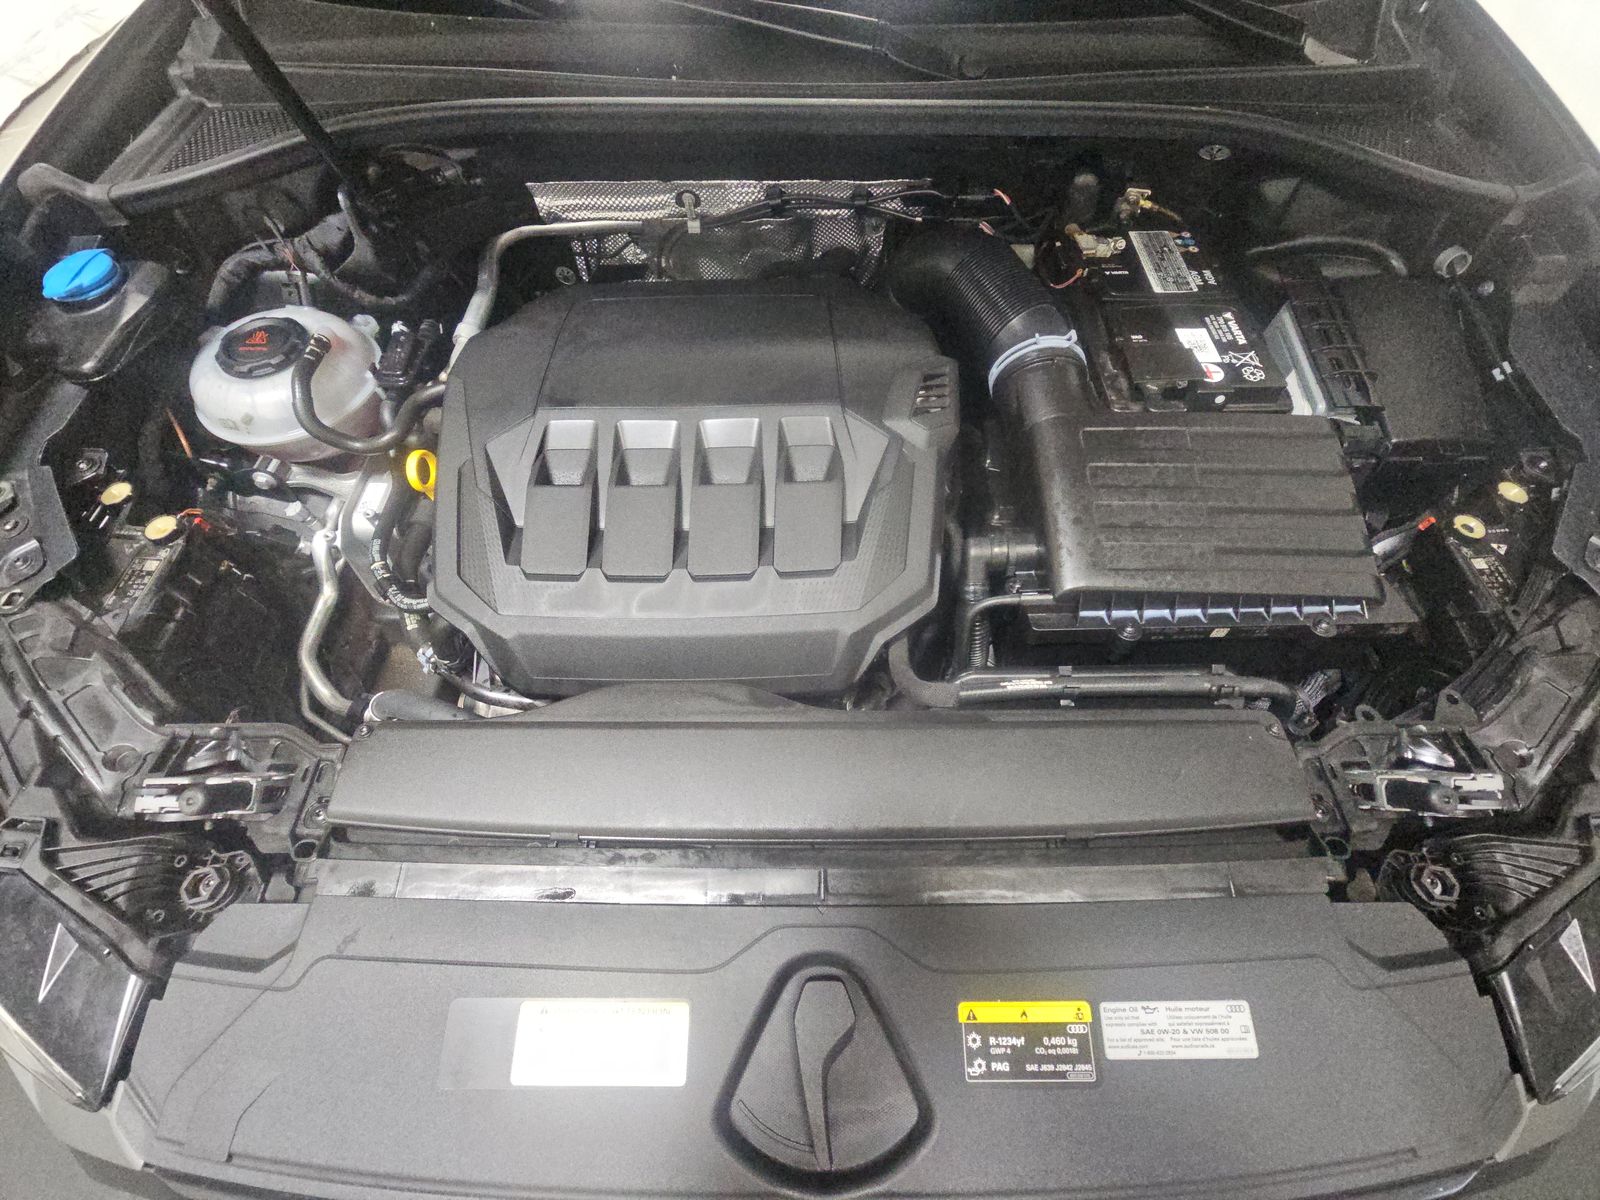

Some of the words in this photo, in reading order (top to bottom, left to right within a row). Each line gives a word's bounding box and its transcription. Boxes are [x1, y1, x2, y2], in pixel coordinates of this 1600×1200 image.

[1202, 269, 1218, 286] AGM
[1227, 319, 1248, 345] VARTA
[1103, 1006, 1127, 1015] Engine
[989, 1037, 1025, 1048] R-1234yf
[1043, 1037, 1066, 1046] 0,460
[1066, 1037, 1078, 1047] kg
[991, 1062, 1010, 1072] PAG
